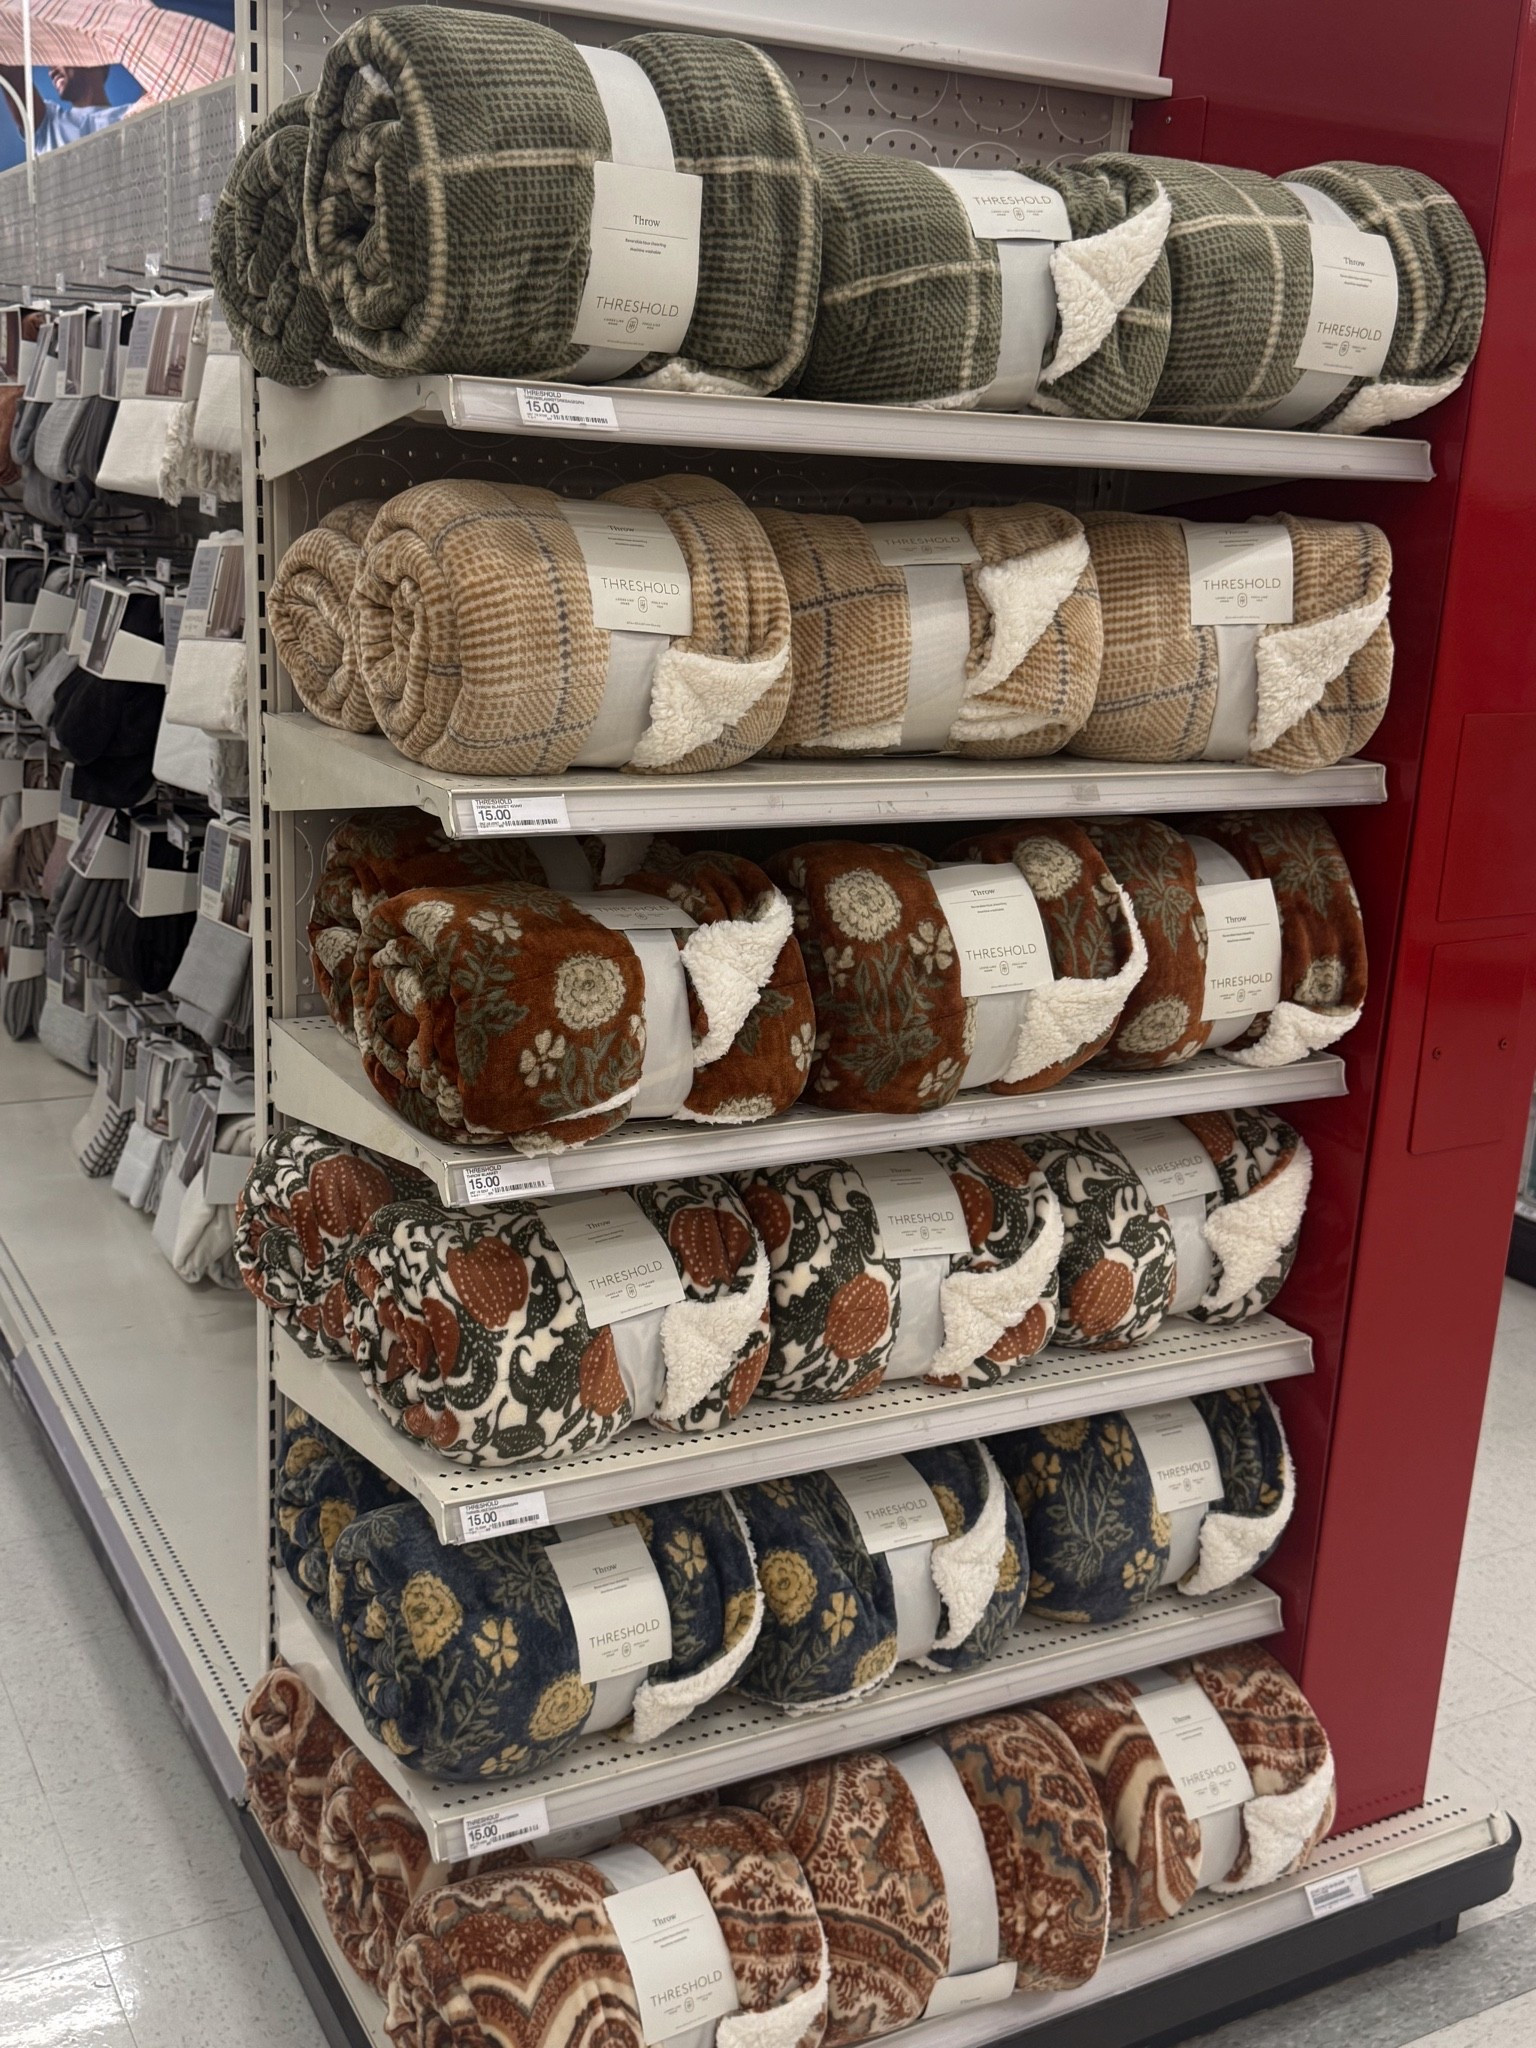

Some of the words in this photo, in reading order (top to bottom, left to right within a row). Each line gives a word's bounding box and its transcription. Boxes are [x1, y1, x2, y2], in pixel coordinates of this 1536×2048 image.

[973, 196, 1051, 205] THRESHOLD
[633, 215, 660, 227] Throw
[1343, 257, 1365, 267] Throw
[596, 296, 679, 318] THRESHOLD
[1317, 321, 1382, 342] THRESHOLD
[526, 400, 560, 414] 15.00
[884, 536, 961, 545] THRESHOLD
[601, 577, 680, 595] THRESHOLD
[1203, 578, 1281, 591] THRESHOLD
[478, 809, 511, 821] 15.00
[970, 888, 996, 897] Throw
[1225, 916, 1247, 924] Throw
[965, 943, 1037, 961] THRESHOLD
[1210, 972, 1273, 990] THRESHOLD
[466, 1165, 501, 1175] THRESHOLD
[1144, 1155, 1203, 1176] THRESHOLD
[469, 1175, 500, 1190] 15.00
[888, 1211, 954, 1225] THRESHOLD
[588, 1260, 663, 1290] THRESHOLD
[1157, 1460, 1211, 1480] THRESHOLD
[466, 1500, 498, 1511] THRESHOLD
[864, 1499, 928, 1520] THRESHOLD
[467, 1511, 498, 1527] 15.00
[593, 1564, 617, 1575] Throw
[589, 1618, 660, 1649] THRESHOLD
[1180, 1761, 1236, 1788] THRESHOLD
[469, 1824, 498, 1841] 15.00
[652, 1913, 677, 1928] Throw
[650, 1970, 723, 2008] THRESHOLD
